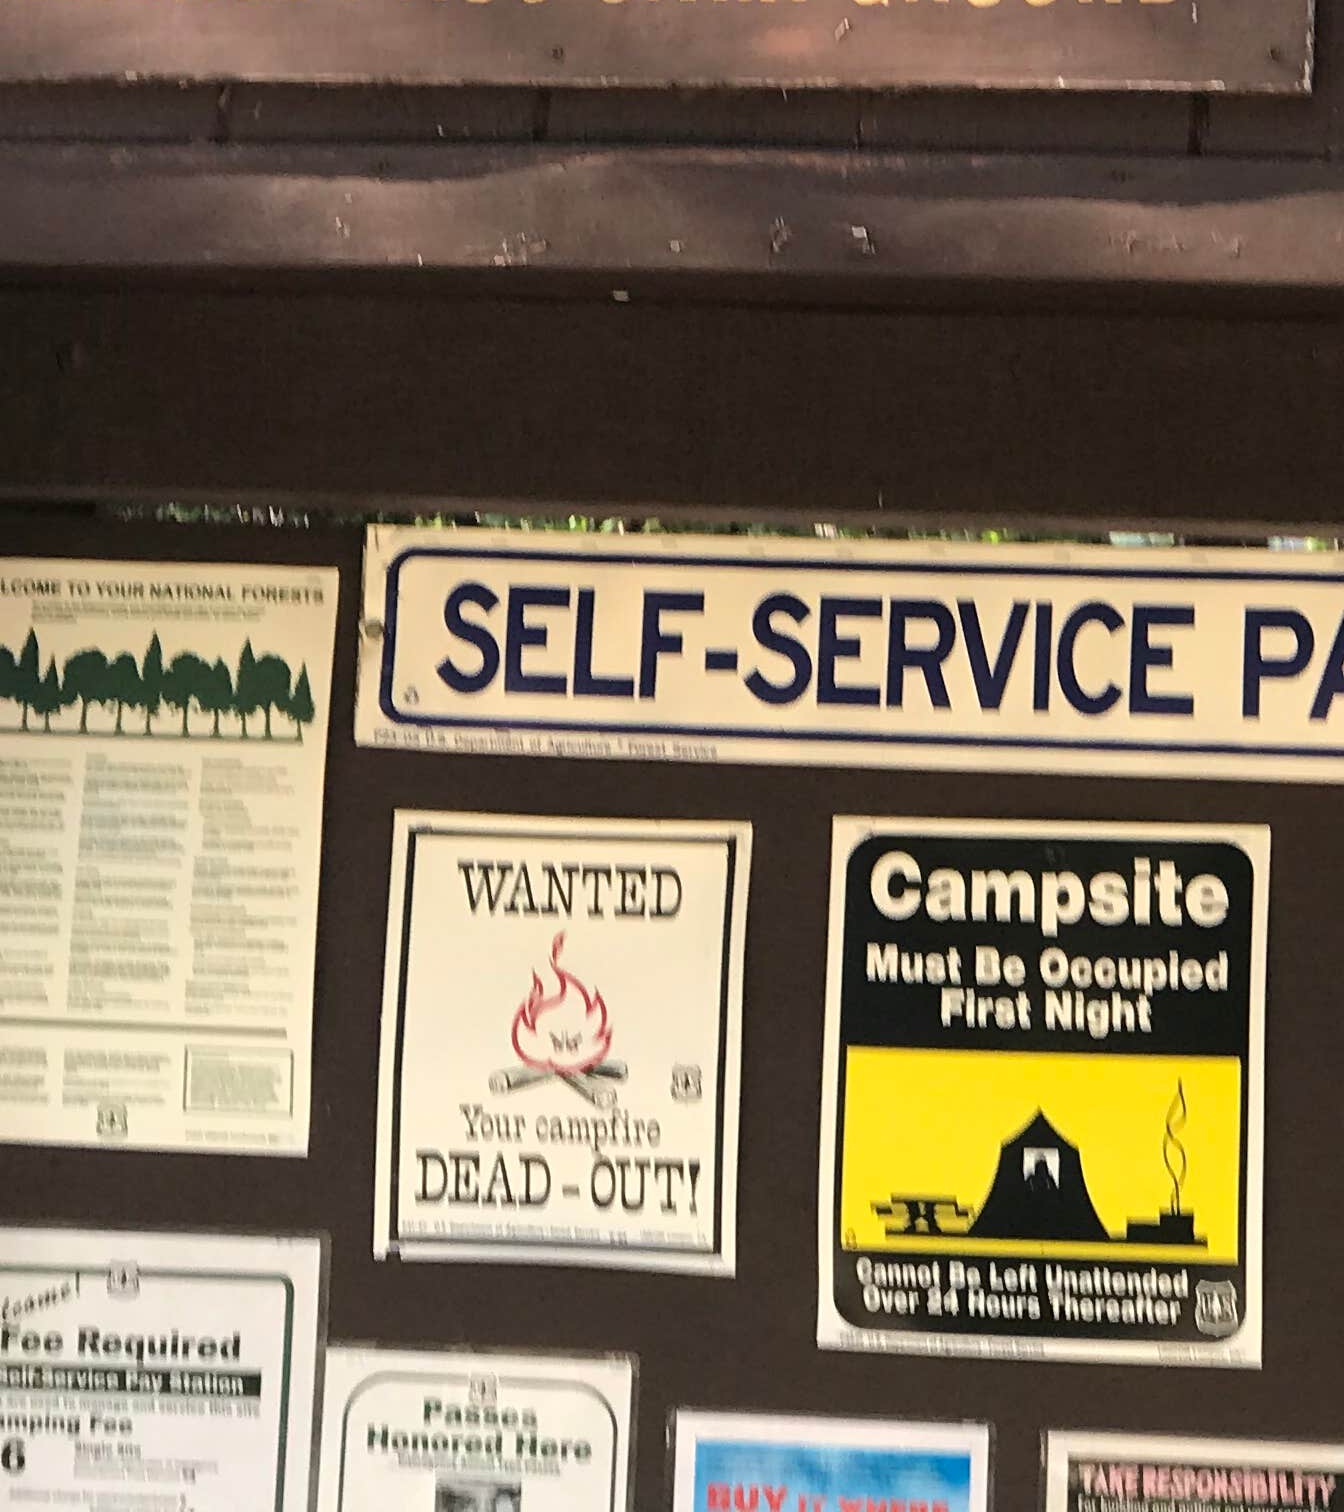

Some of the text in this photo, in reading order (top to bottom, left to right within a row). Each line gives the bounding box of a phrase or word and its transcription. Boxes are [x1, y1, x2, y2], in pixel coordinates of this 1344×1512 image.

[68, 578, 90, 598] TO
[97, 579, 144, 599] YOUR
[149, 581, 233, 602] NATIONAL
[241, 583, 325, 606] FORESTS
[438, 583, 1195, 717] SELF-SERVICE
[457, 859, 683, 919] WANTED
[869, 849, 1230, 937] Campsite
[866, 942, 1230, 996] Must Be Occupied
[940, 988, 1155, 1040] First Night
[459, 1104, 661, 1156] Your campfire
[856, 1255, 1189, 1299] Cannot Be Left Unattended
[863, 1283, 920, 1315] Over
[927, 1287, 959, 1317] 24
[968, 1288, 1041, 1321] Hours
[1047, 1288, 1182, 1328] Thereafter
[1, 1323, 241, 1368] Fee Required
[90, 1413, 133, 1436] Fee
[423, 1396, 538, 1429] Passes
[367, 1421, 503, 1457] Honored
[515, 1431, 593, 1466] Here
[708, 1481, 788, 1512] BUY
[1078, 1462, 1337, 1508] TAKE RESPONSIBILITY
